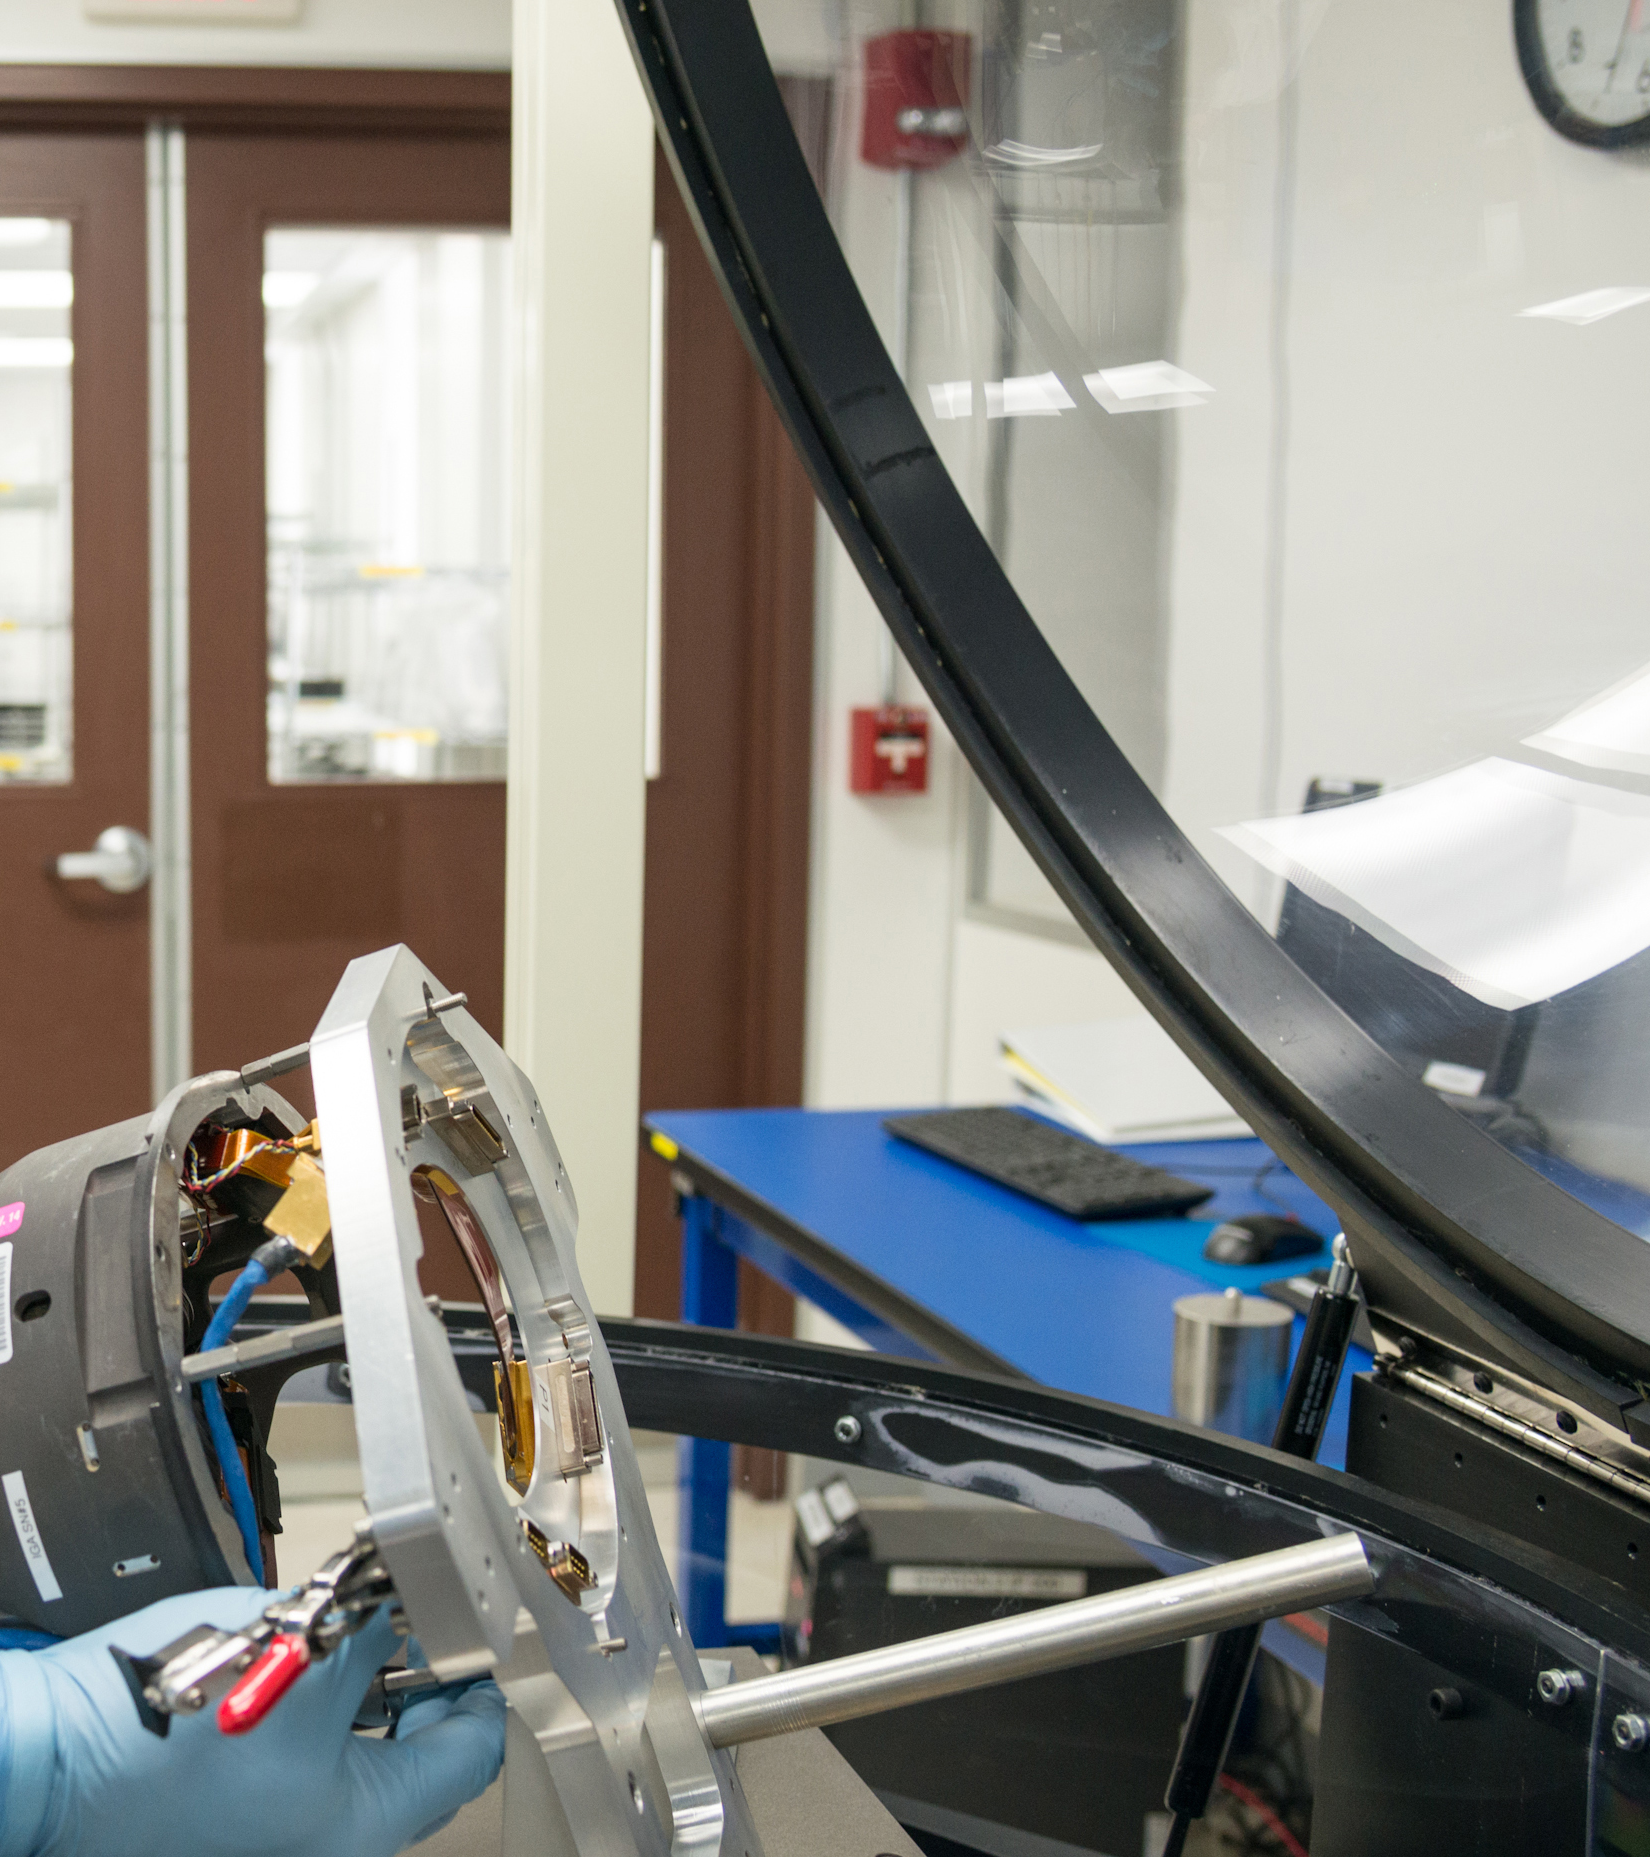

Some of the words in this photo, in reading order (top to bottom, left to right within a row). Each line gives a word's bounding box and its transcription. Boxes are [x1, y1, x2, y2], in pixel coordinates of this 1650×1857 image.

[1568, 27, 1584, 63] 8
[9, 1210, 20, 1223] 14
[15, 1499, 33, 1532] SN#5
[27, 1536, 41, 1558] IGA
